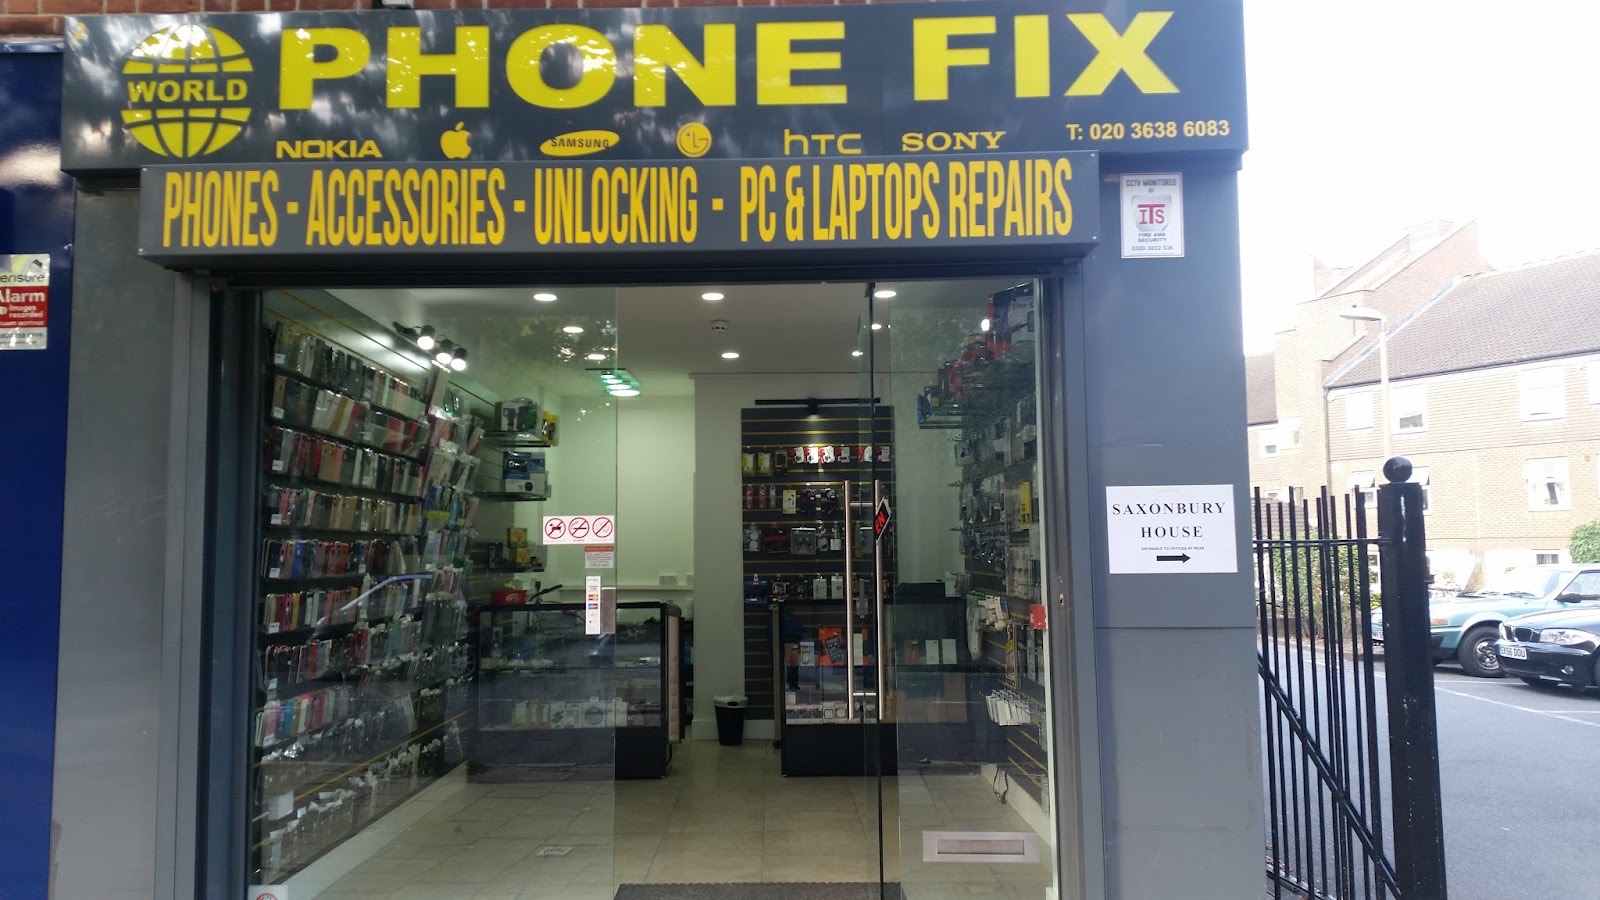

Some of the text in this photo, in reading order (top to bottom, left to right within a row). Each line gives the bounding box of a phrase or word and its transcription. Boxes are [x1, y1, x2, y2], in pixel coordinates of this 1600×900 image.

[278, 11, 1179, 111] PHONE FIX
[128, 78, 248, 103] WORLD
[1066, 119, 1230, 140] T: 020 3638 6083
[276, 140, 383, 160] NOKIA
[550, 138, 609, 148] SAMSUNG
[901, 131, 1006, 152] SONY
[1143, 178, 1177, 186] MONITORED
[163, 168, 280, 248] PHONES
[305, 167, 507, 247] ACCESSORIES
[533, 165, 699, 246] UNLOCKING
[739, 164, 778, 243] PC
[785, 165, 806, 242] &
[811, 161, 941, 242] LAPTOPS
[948, 158, 1074, 239] REPAIRS
[1137, 203, 1166, 225] ITS
[9, 311, 44, 319] recorded
[1112, 502, 1226, 516] SAXONBURY
[1141, 525, 1203, 539] HOUSE
